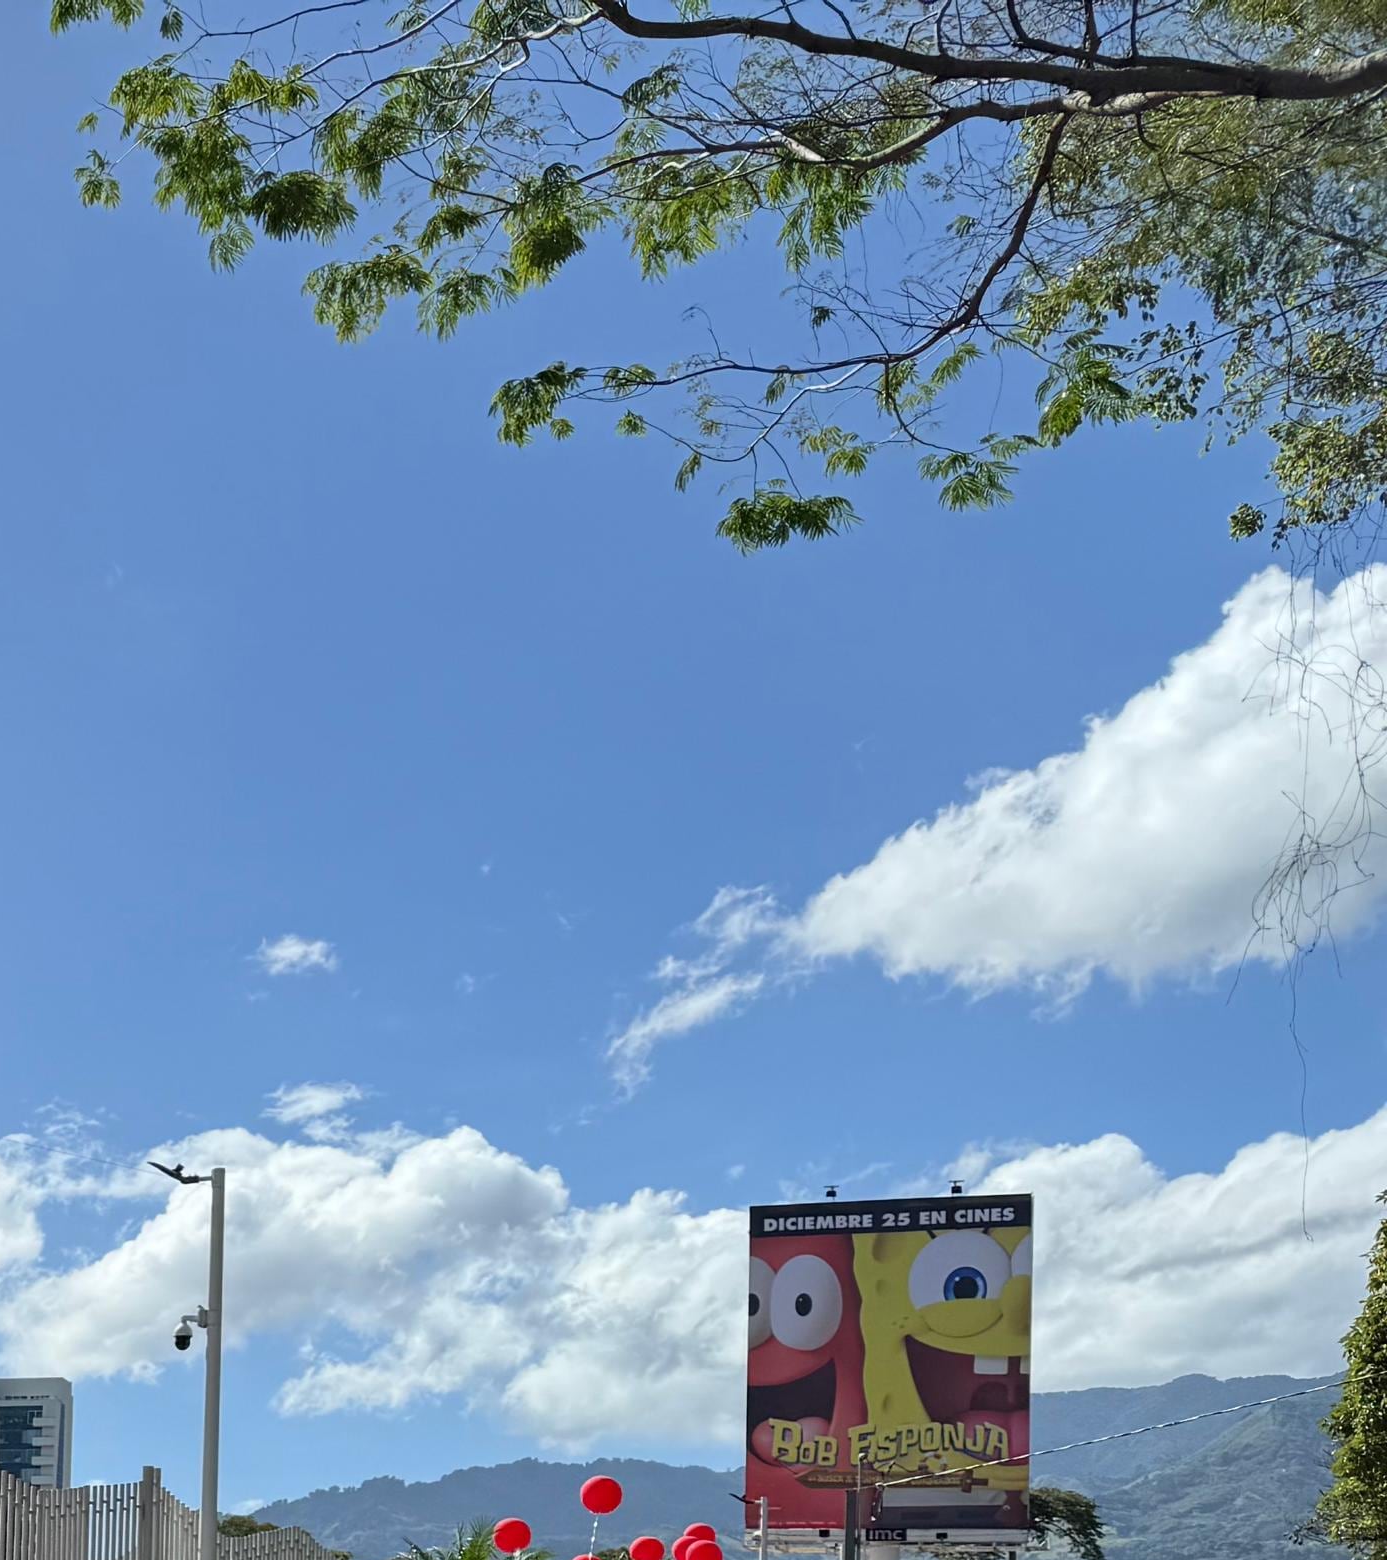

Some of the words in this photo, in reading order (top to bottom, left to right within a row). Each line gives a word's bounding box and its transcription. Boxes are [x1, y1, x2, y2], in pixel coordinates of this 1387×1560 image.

[763, 1213, 873, 1232] DICIEMBRE
[881, 1212, 911, 1227] 25
[919, 1210, 947, 1225] EN
[954, 1207, 1015, 1223] CINES
[847, 1421, 1010, 1466] ESPONJA
[868, 1528, 904, 1541] imc
